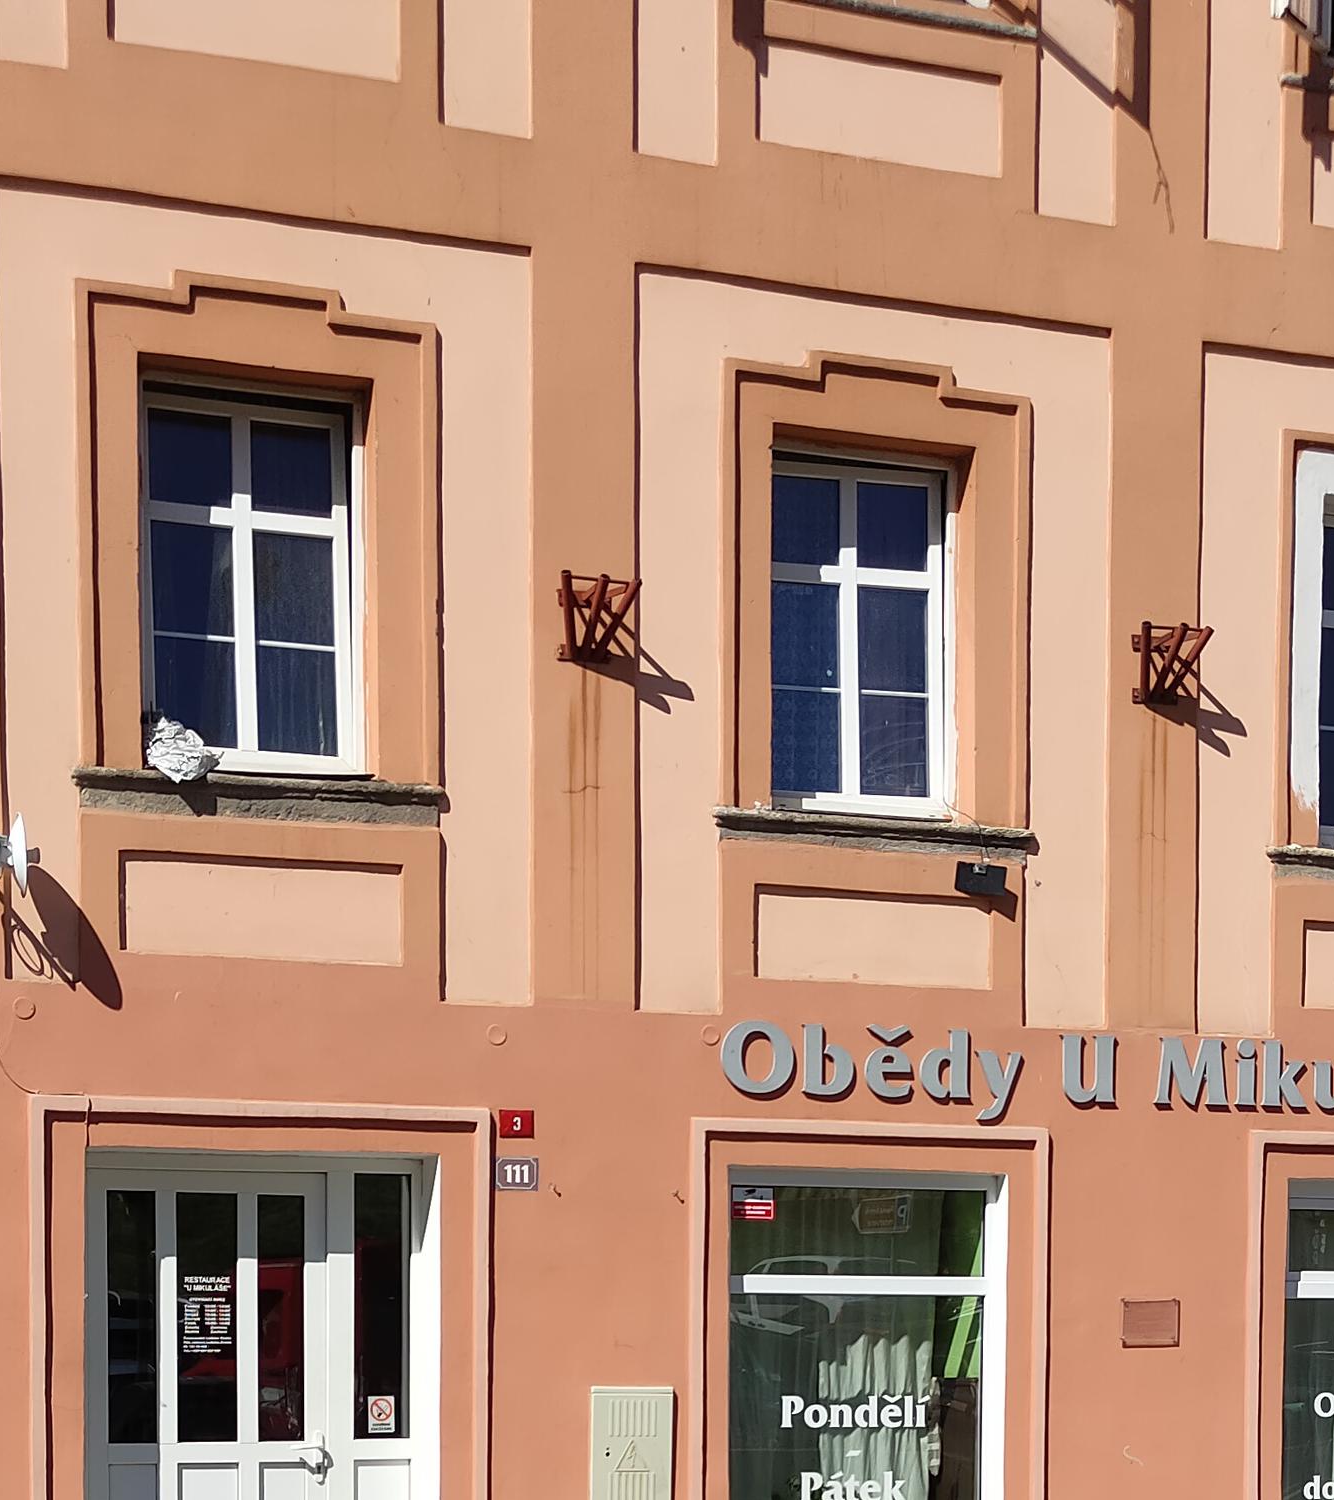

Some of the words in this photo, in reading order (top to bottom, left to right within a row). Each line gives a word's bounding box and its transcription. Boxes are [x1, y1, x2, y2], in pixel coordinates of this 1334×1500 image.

[720, 1020, 1024, 1124] Obědy
[1059, 1034, 1119, 1109] U
[513, 1117, 521, 1131] 3
[504, 1165, 529, 1183] 111
[184, 1276, 231, 1284] RESTAURACE
[780, 1393, 931, 1429] Pondělí
